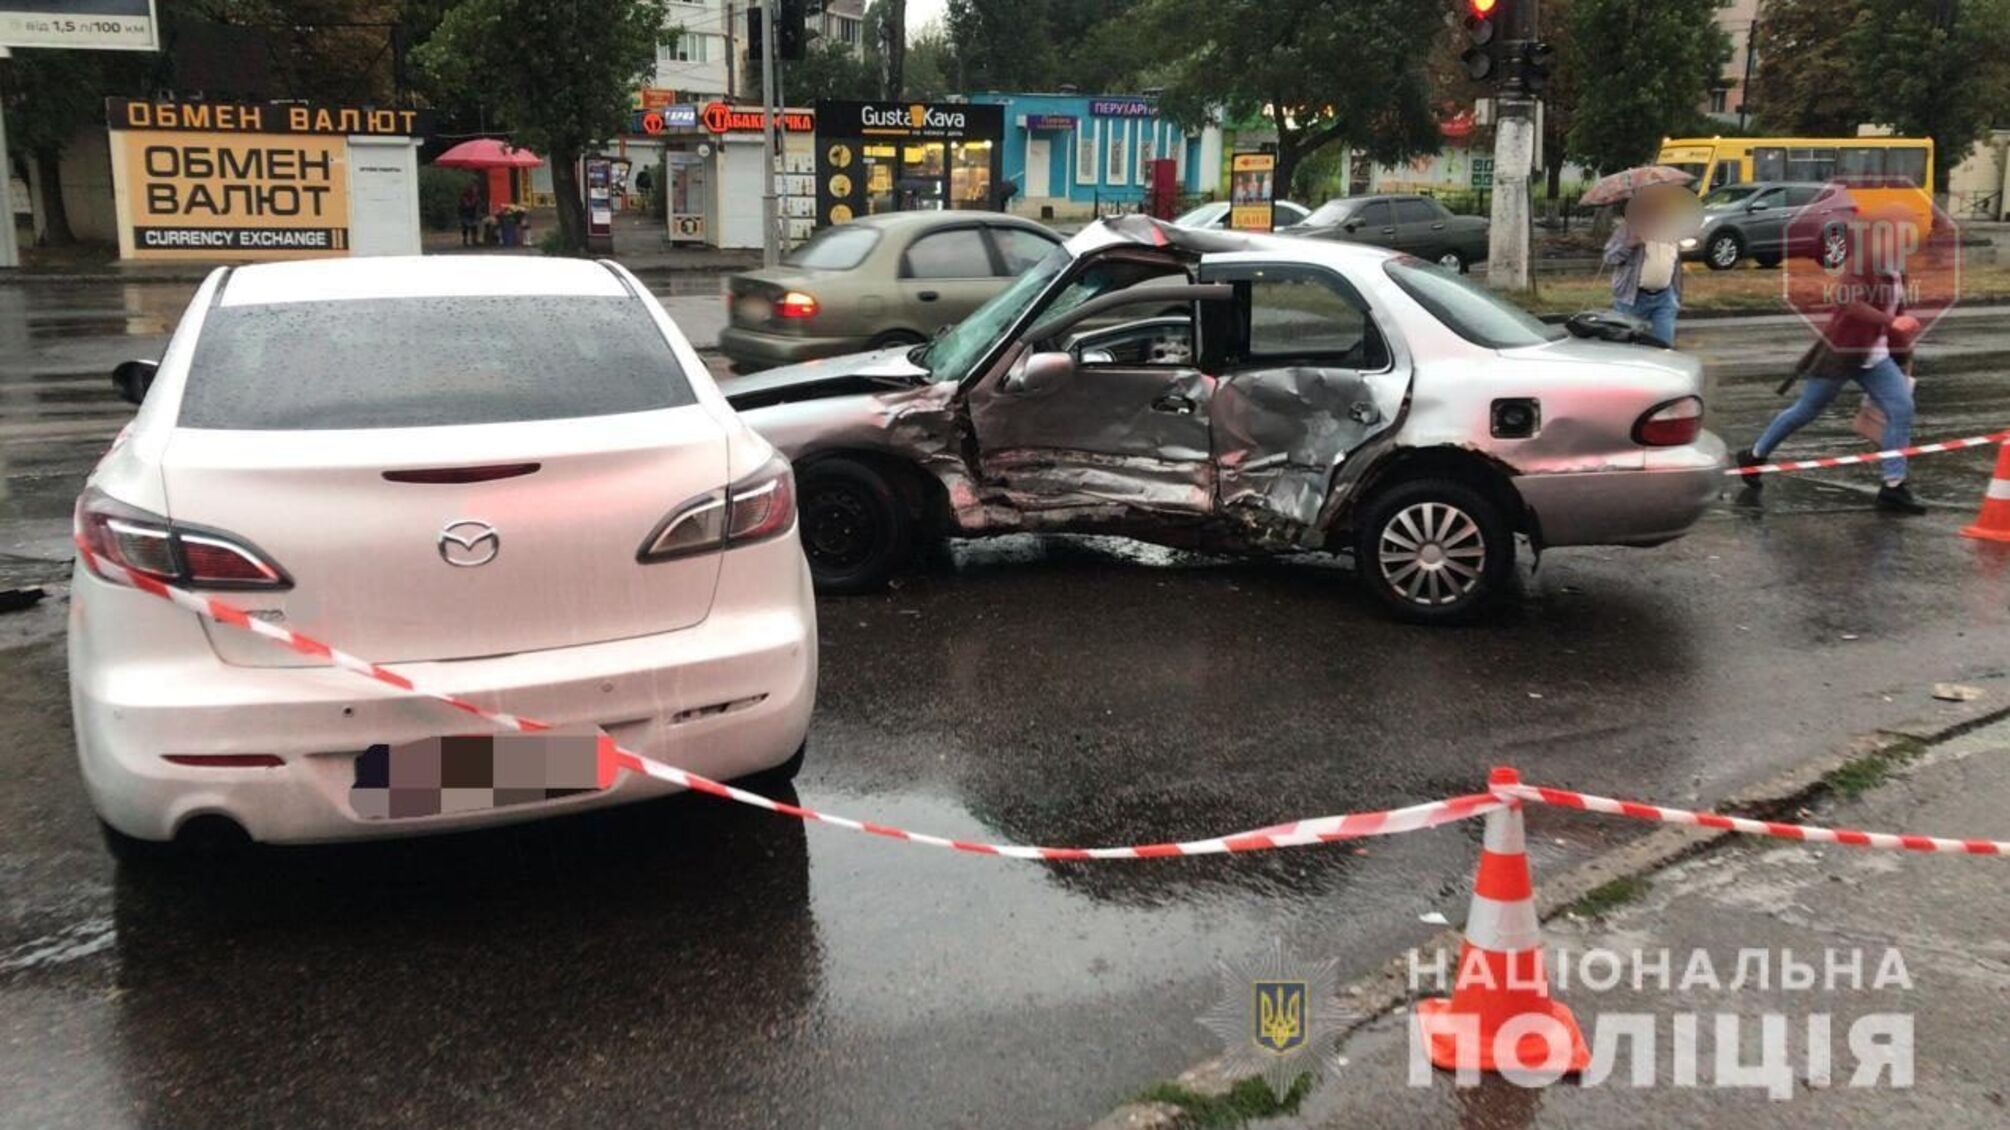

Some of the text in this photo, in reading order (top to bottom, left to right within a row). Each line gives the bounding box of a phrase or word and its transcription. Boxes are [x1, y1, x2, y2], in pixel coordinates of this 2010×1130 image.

[52, 20, 76, 34] 1,5
[127, 102, 417, 133] ОБМЕН ВАЛЮТ
[708, 106, 812, 130] ТАБАКЕЧКА
[924, 106, 966, 128] Kava
[144, 145, 331, 180] ОБМЕН
[146, 182, 331, 217] ВАЛЮТ
[145, 230, 327, 246] CURRENCY EXCHANGE
